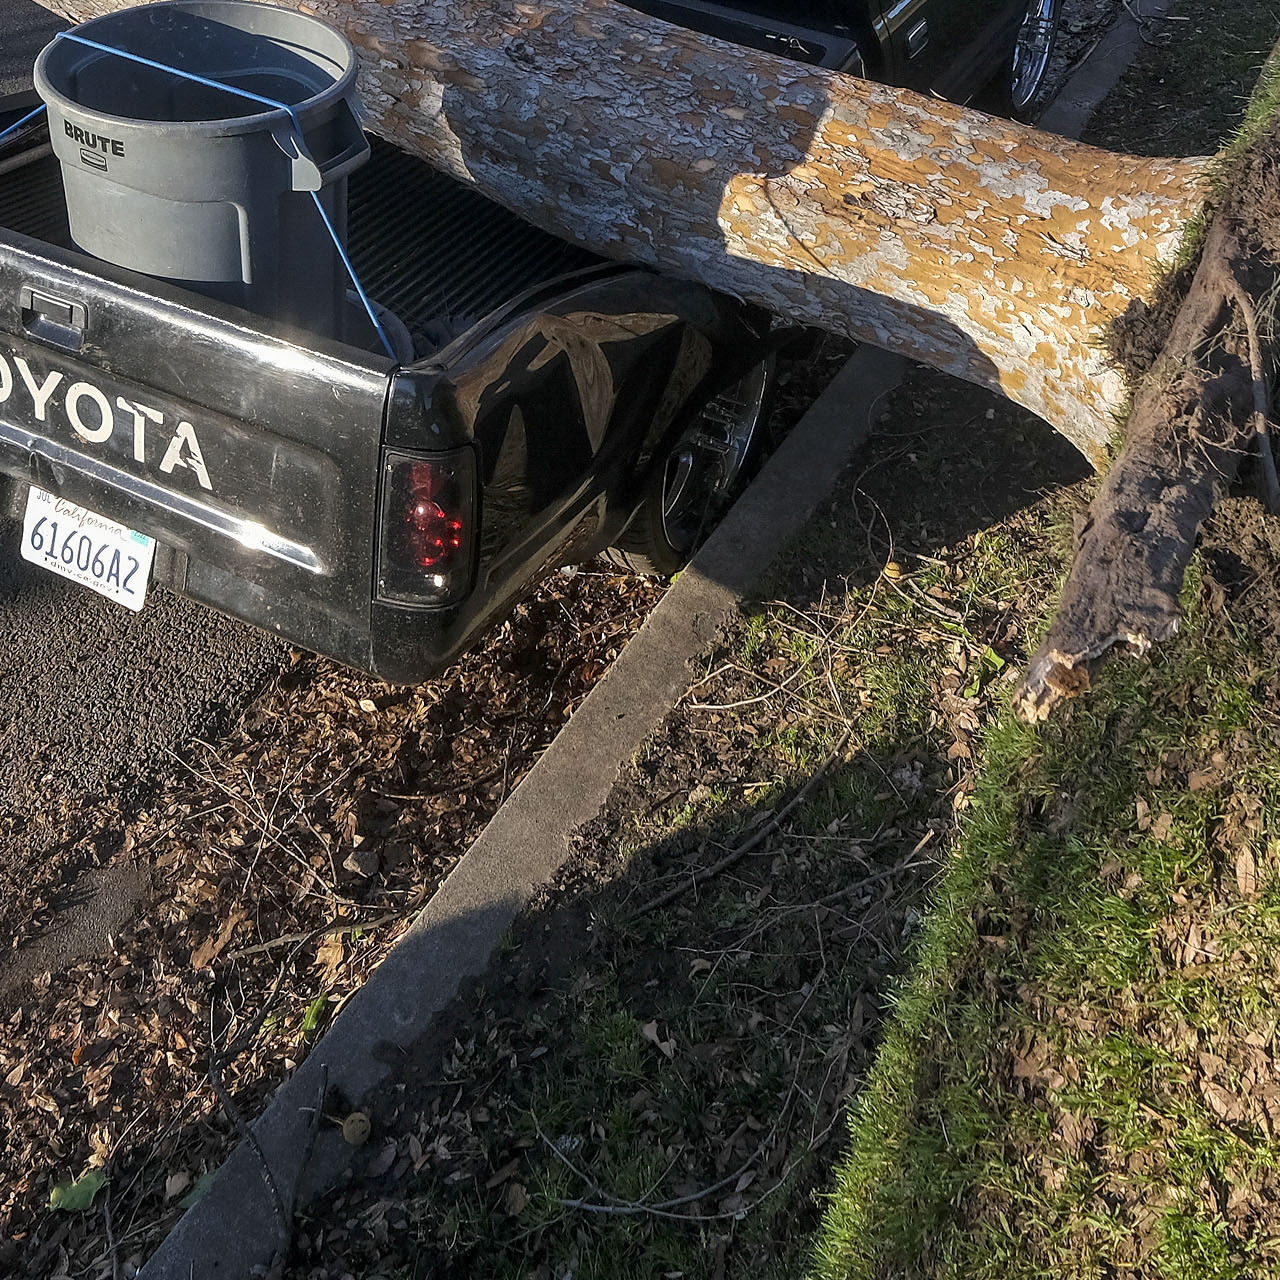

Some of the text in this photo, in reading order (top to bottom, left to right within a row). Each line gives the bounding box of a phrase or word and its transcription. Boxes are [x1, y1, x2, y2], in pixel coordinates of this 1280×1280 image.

[63, 118, 125, 158] BRUTE
[54, 497, 128, 542] California
[30, 516, 140, 595] 61606A2
